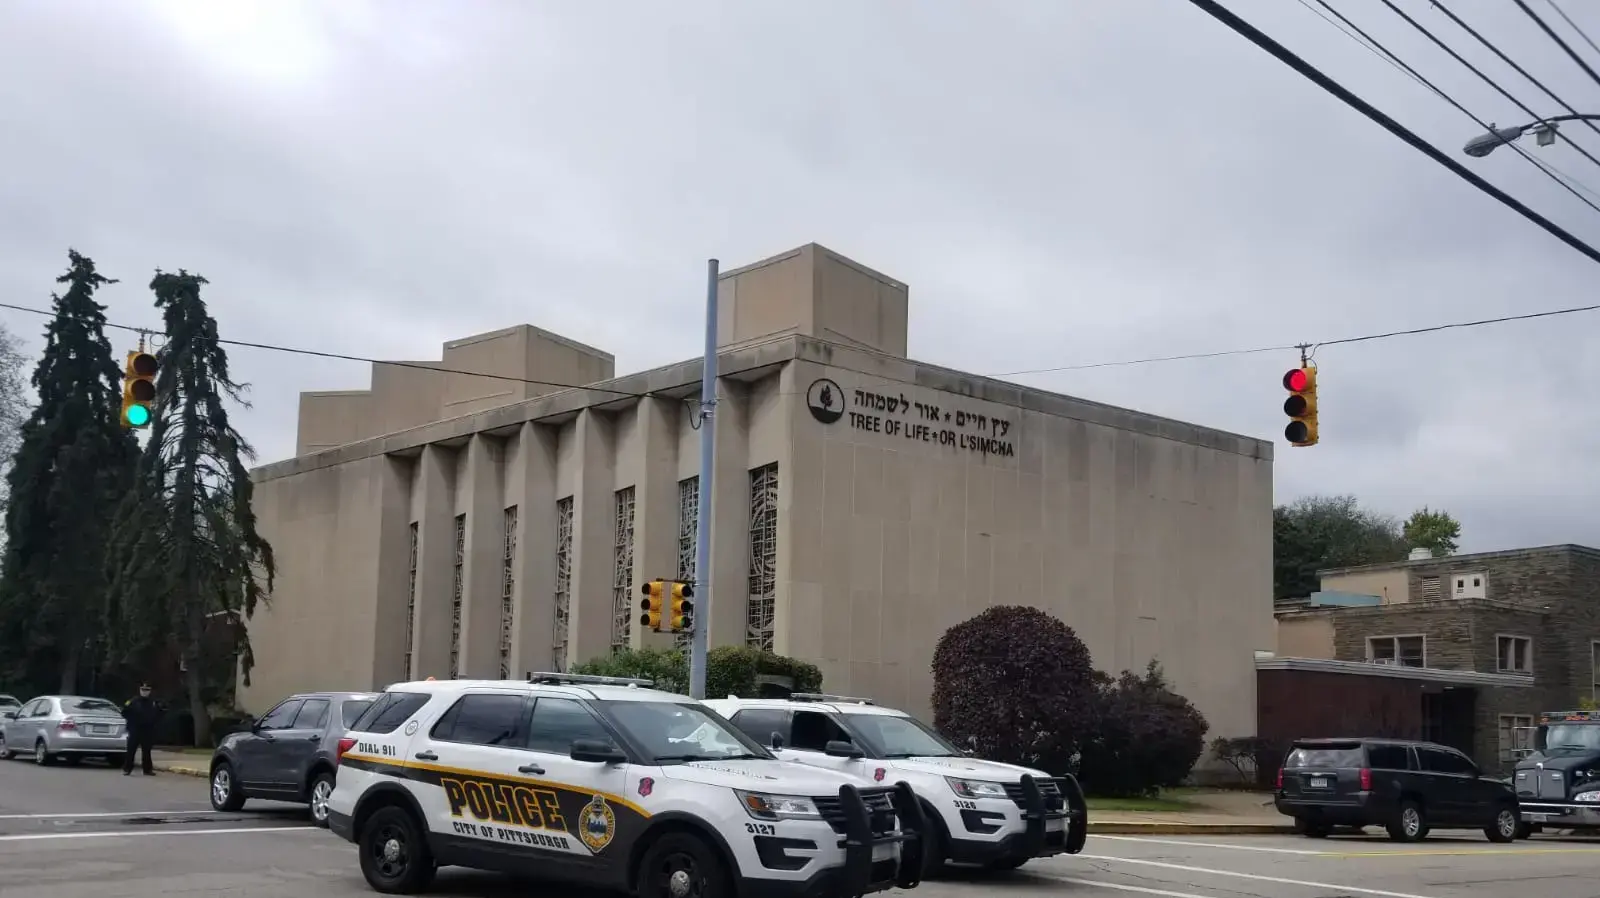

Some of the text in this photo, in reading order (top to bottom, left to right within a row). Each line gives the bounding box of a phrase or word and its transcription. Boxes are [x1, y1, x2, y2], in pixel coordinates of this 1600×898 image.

[854, 389, 1010, 437] עץ חיים אור לשמחה
[848, 411, 1014, 457] TREE OF LIFE OR L'SIMCHA
[359, 742, 396, 756] DIAL 911
[440, 777, 568, 833] POLICE
[952, 800, 977, 810] 3126
[452, 821, 571, 850] CITY OF PITTSBURGH
[744, 822, 776, 836] 3127
